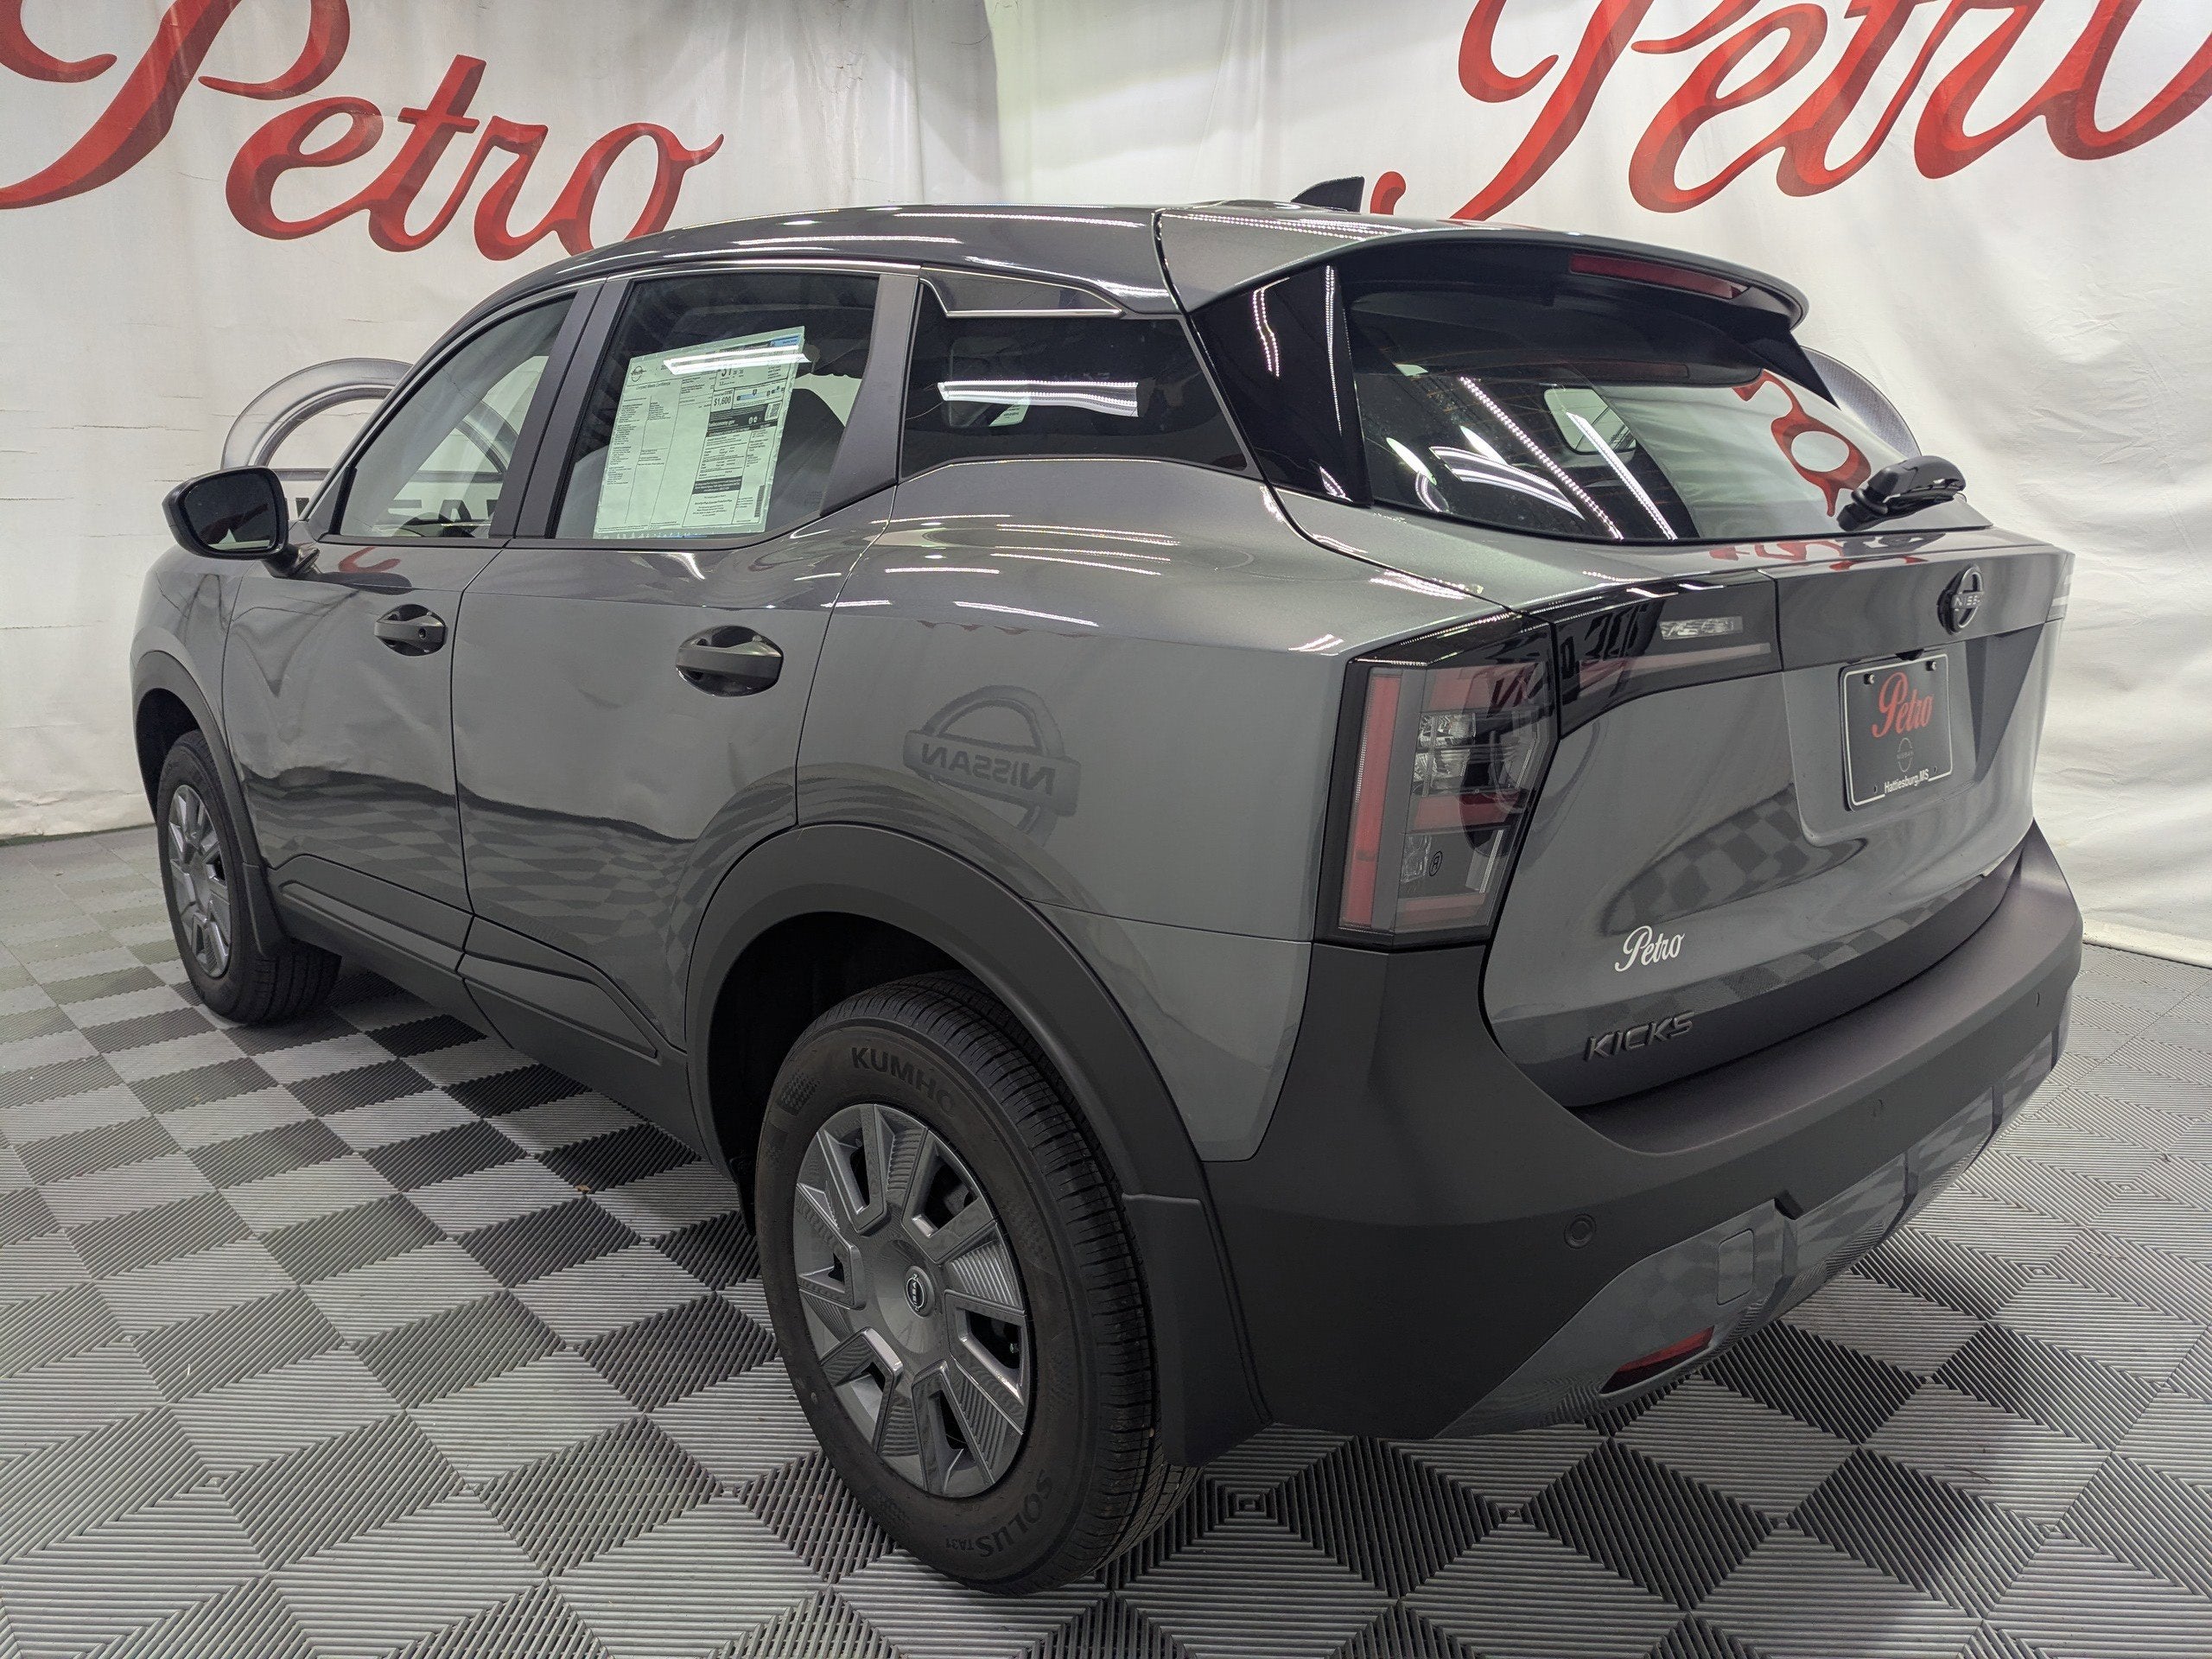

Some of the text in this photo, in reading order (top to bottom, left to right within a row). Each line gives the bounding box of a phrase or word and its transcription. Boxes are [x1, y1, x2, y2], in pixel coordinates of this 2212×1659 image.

[0, 0, 725, 261] Petro
[1871, 671, 1935, 738] Petro
[1614, 925, 1686, 973] Petro
[1583, 1010, 1695, 1061] KICKS
[851, 1047, 955, 1118] KUMHO
[976, 1470, 1052, 1558] SOLUS
